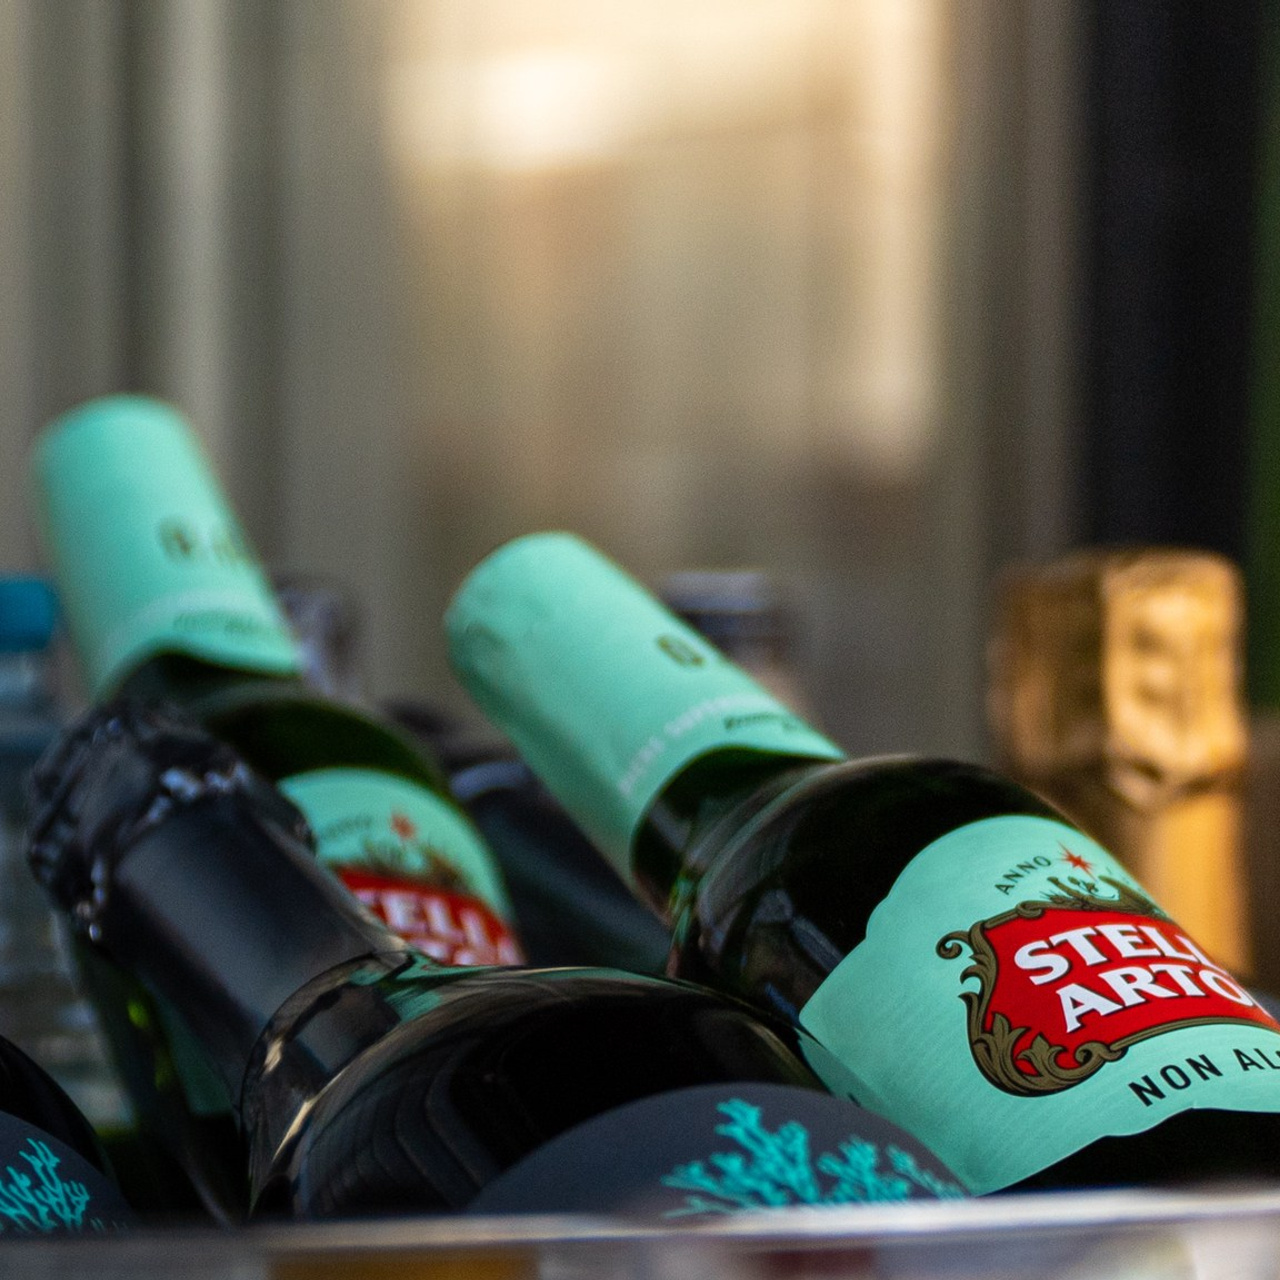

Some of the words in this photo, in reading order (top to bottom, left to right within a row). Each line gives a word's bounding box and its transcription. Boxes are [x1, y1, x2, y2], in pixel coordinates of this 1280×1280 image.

[994, 855, 1052, 896] ANNO
[1056, 963, 1268, 1033] ARTO
[1128, 1053, 1223, 1107] NON
